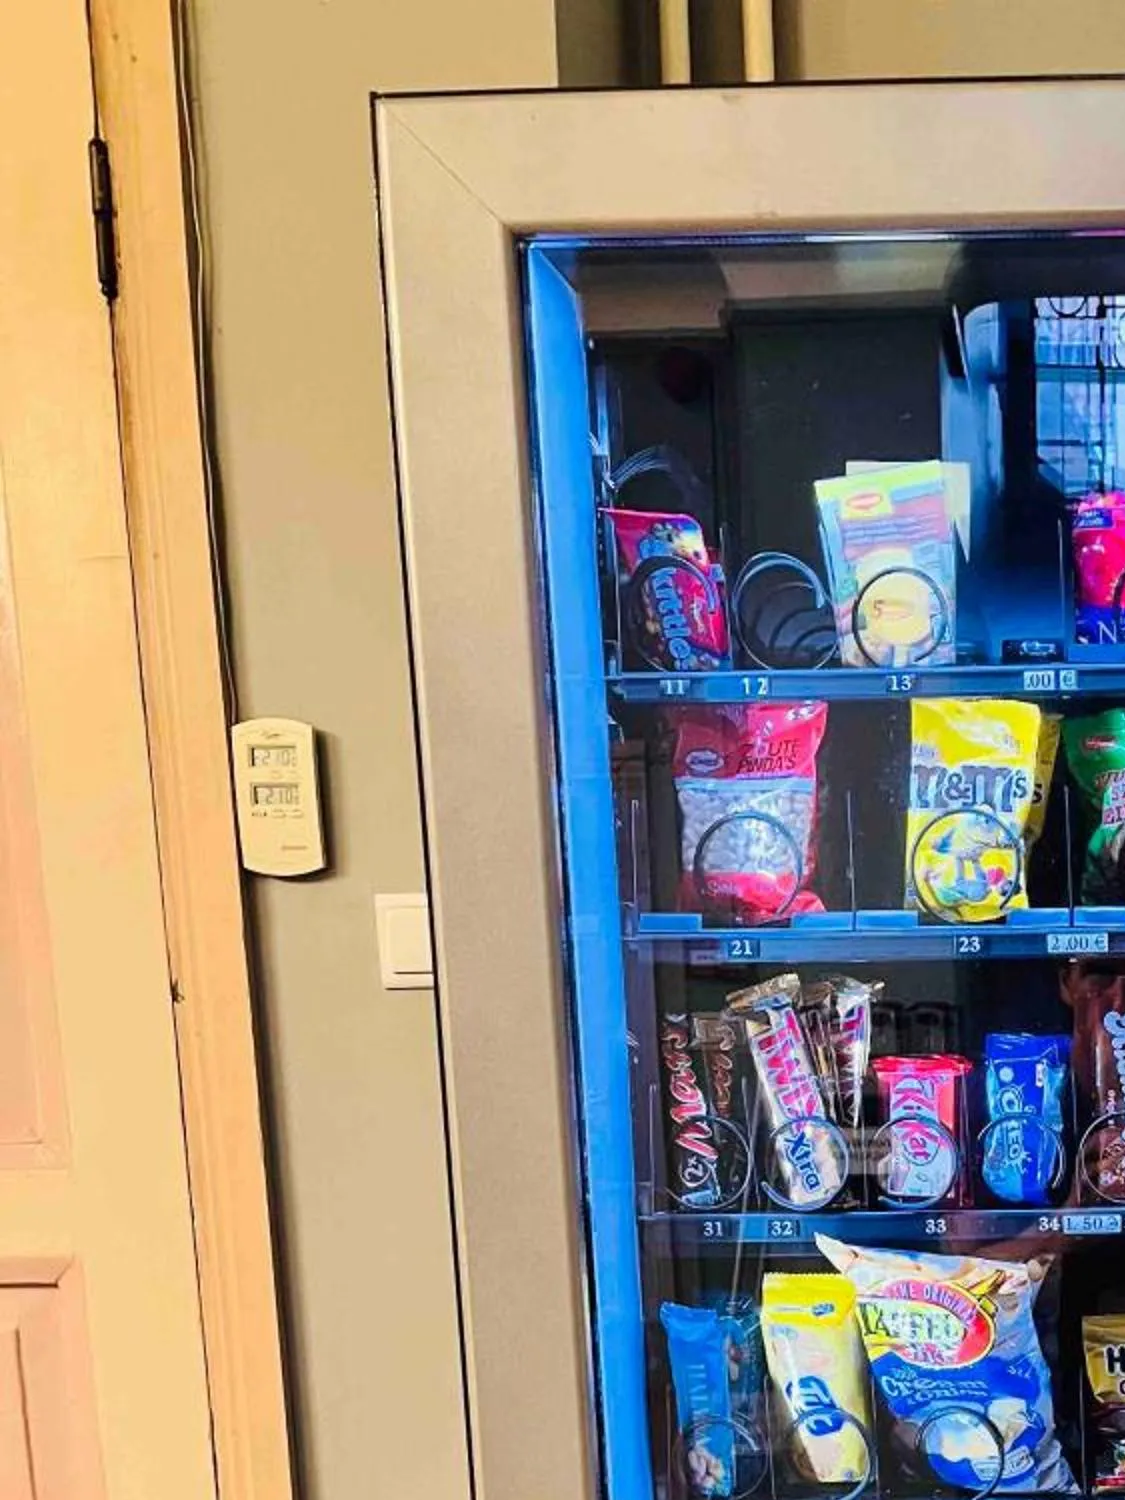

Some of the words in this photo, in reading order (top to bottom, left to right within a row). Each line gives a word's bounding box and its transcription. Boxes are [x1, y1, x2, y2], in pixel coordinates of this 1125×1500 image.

[665, 680, 686, 695] 11
[743, 677, 768, 695] 12
[888, 675, 914, 692] 13
[730, 938, 754, 955] 21
[959, 937, 981, 952] 23
[785, 1131, 821, 1191] Xtra
[704, 1221, 724, 1237] 31
[771, 1220, 794, 1236] 32
[925, 1219, 947, 1235] 33
[1037, 1216, 1061, 1232] 34
